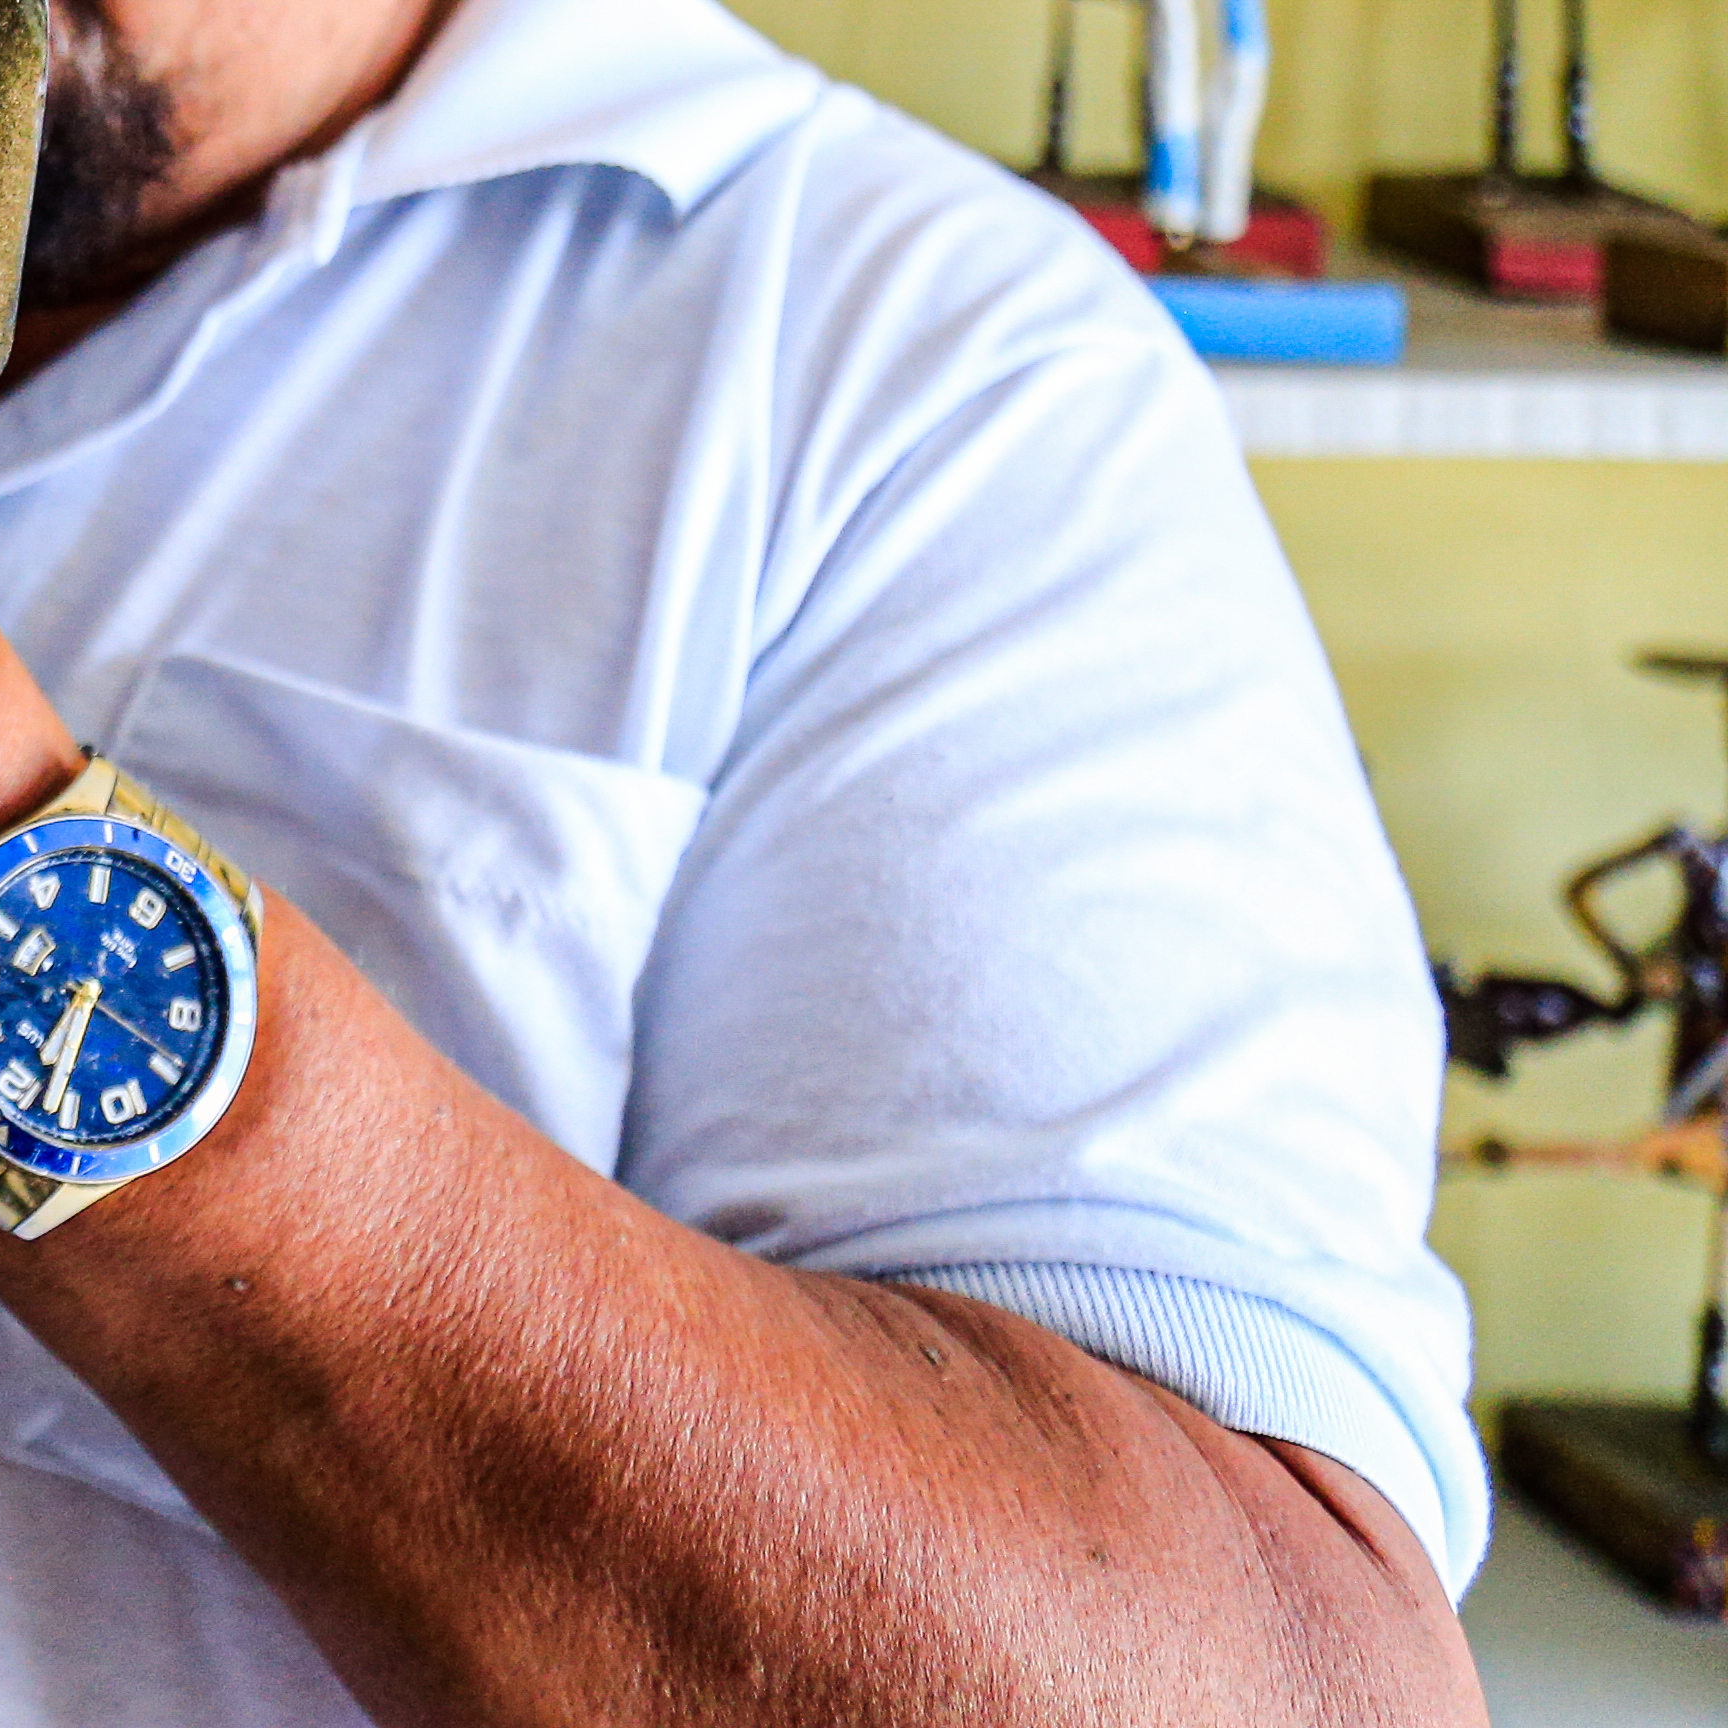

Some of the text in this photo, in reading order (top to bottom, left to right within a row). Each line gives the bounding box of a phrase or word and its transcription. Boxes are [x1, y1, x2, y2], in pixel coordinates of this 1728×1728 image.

[165, 850, 197, 884] 30
[28, 872, 62, 911] 4
[128, 886, 167, 930] 6
[168, 996, 203, 1033] 8
[17, 1020, 44, 1050] LUS
[101, 1078, 148, 1125] 10
